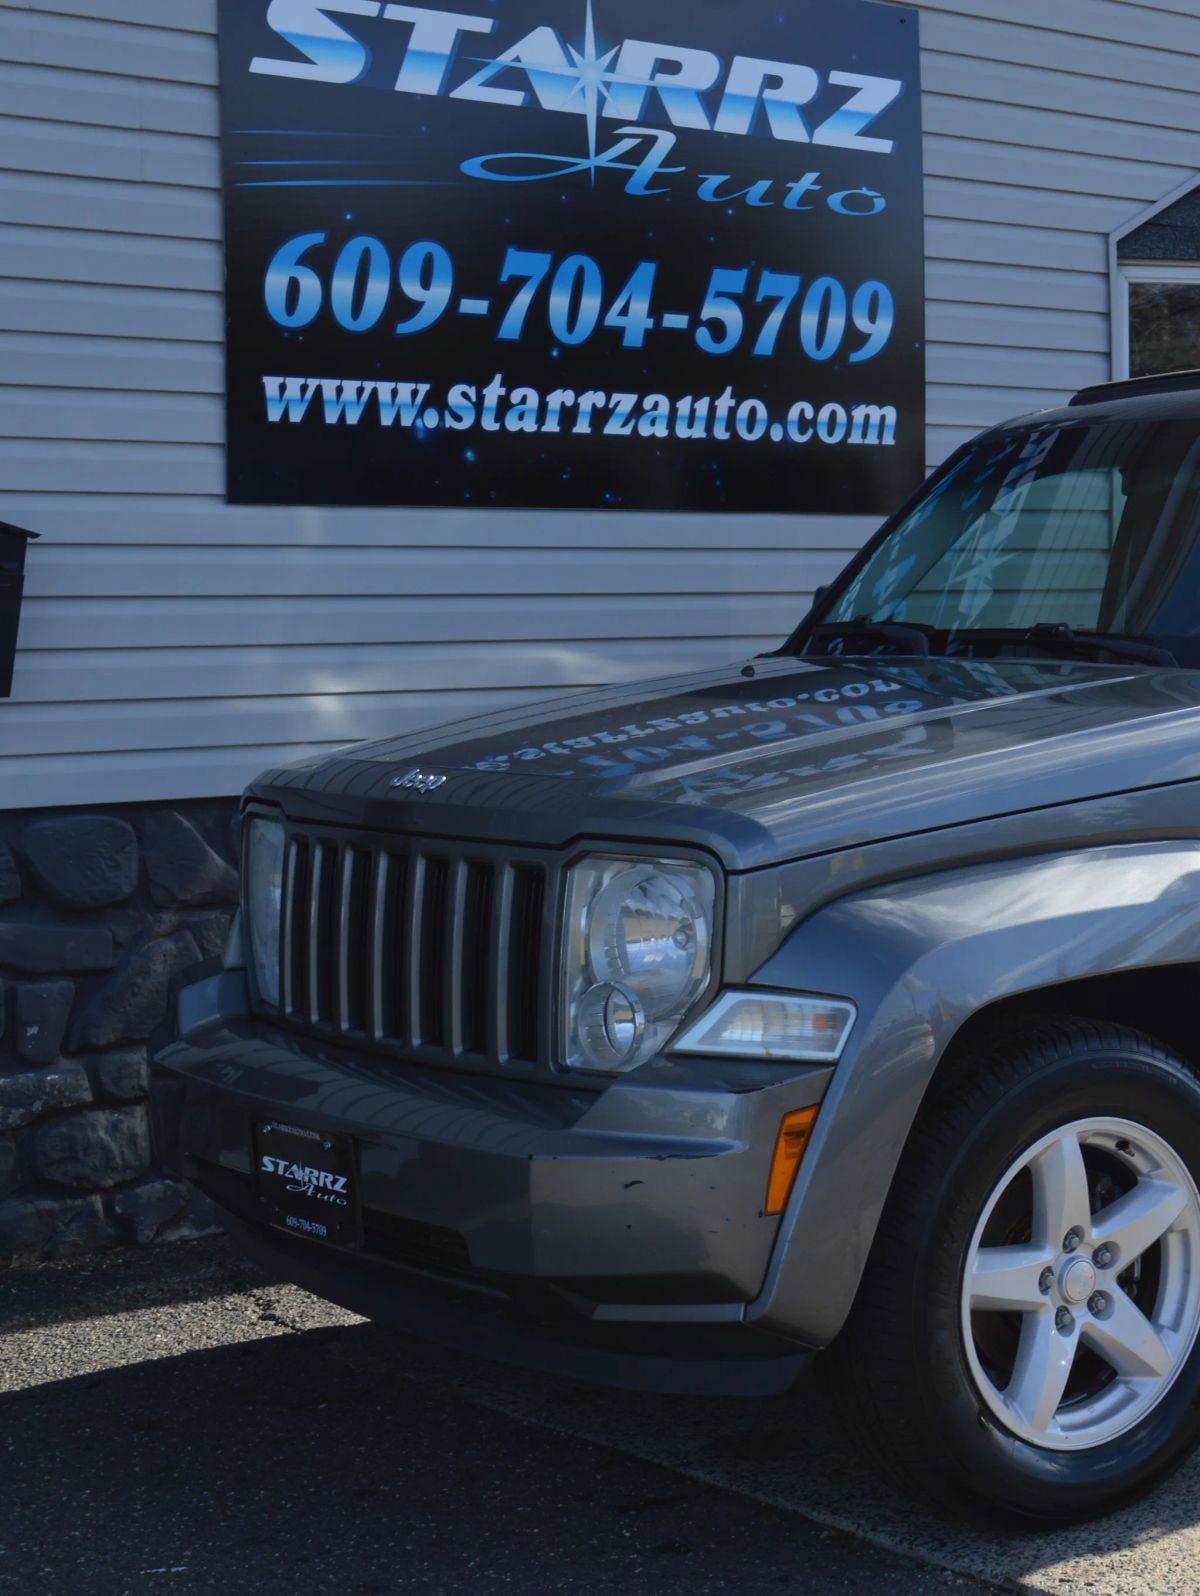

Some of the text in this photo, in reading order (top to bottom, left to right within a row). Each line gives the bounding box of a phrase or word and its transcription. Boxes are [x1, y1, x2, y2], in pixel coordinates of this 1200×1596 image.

[248, 0, 902, 154] STARRZ
[459, 126, 887, 216] Auto
[263, 232, 895, 365] 609-704-5709
[262, 373, 897, 446] www.starrzauto.com
[389, 768, 447, 795] Jeep
[261, 1156, 348, 1193] STARRZ
[286, 1182, 348, 1206] Auto
